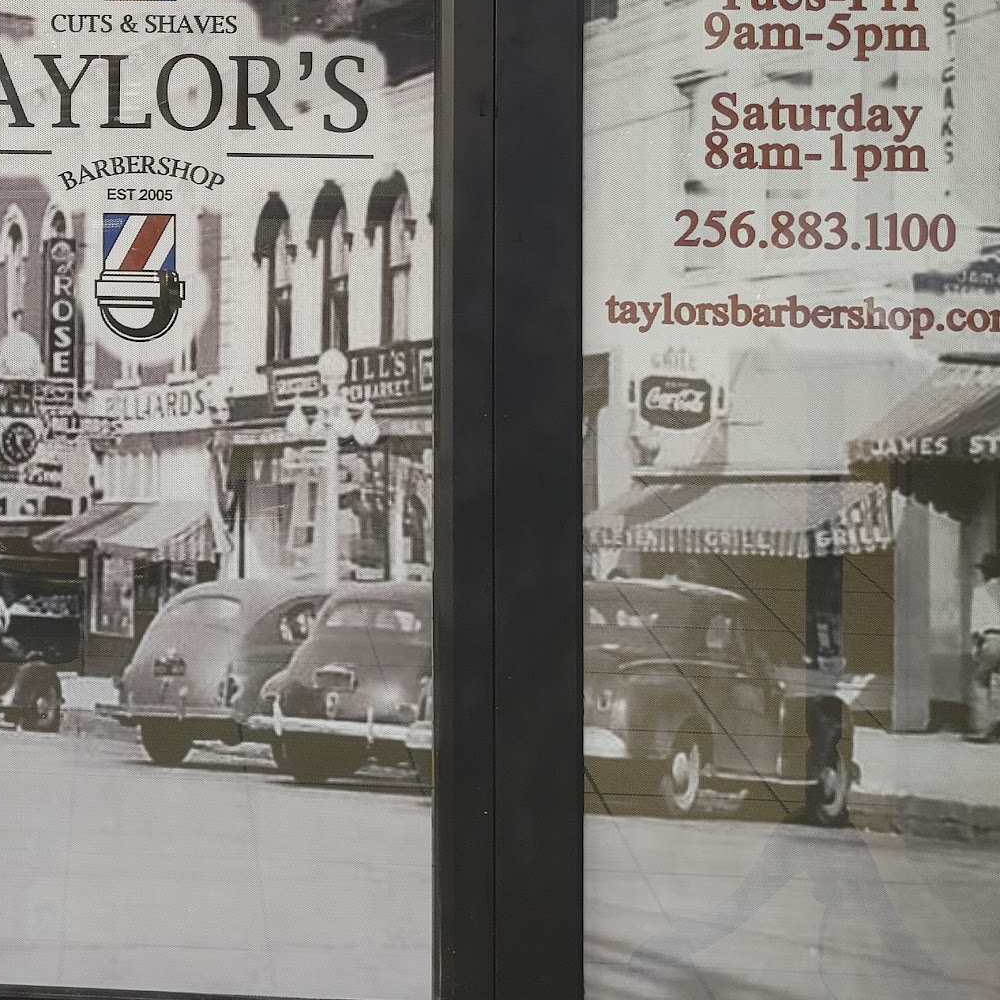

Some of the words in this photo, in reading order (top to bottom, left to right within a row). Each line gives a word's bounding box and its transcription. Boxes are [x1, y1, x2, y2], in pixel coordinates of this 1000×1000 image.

[50, 13, 113, 34] CUTS
[120, 14, 138, 34] &
[144, 13, 238, 35] SHAVES
[703, 12, 930, 62] 9am-5pm
[711, 92, 922, 142] Saturday
[58, 156, 226, 192] BARBERSHOP
[704, 132, 928, 182] 8am-1pm
[106, 188, 135, 202] EST
[138, 188, 173, 202] 2005
[673, 208, 957, 252] 256.883.1100
[871, 436, 948, 457] JAMES
